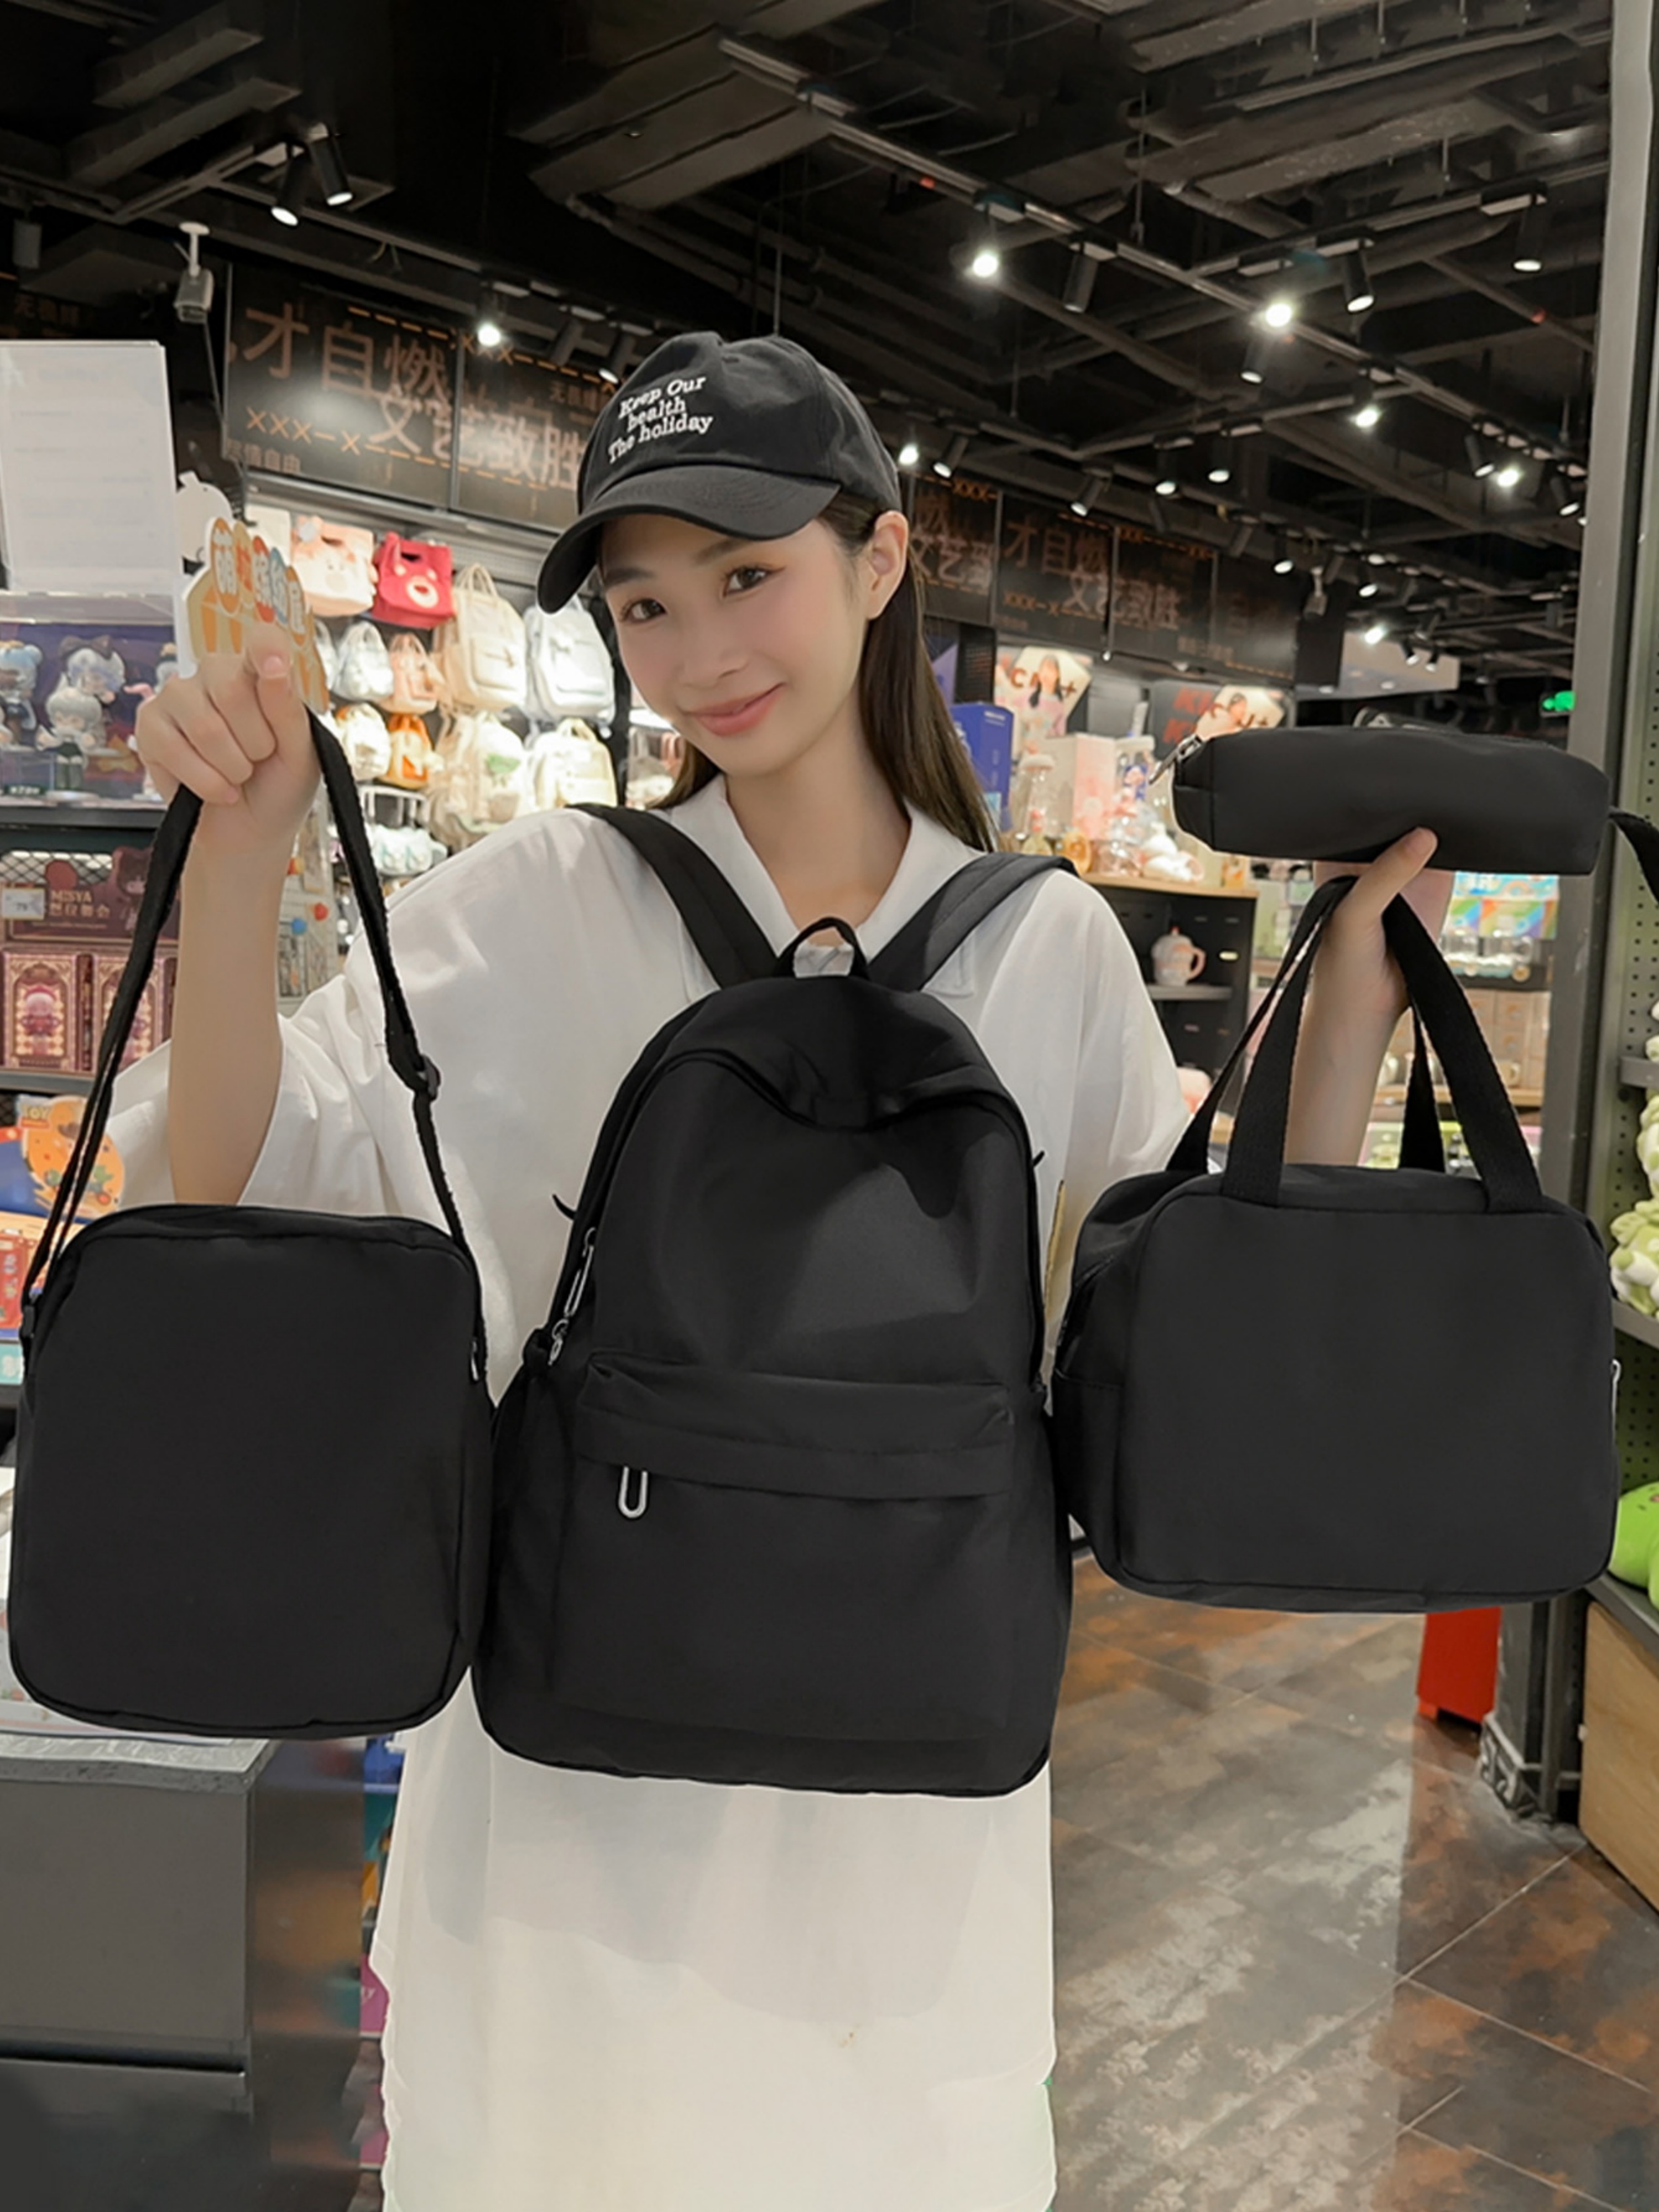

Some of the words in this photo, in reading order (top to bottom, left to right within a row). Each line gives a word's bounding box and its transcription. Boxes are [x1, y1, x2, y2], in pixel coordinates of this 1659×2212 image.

[618, 388, 661, 419] Keep
[666, 377, 707, 395] Our
[608, 435, 635, 465] The
[638, 413, 713, 443] holiday
